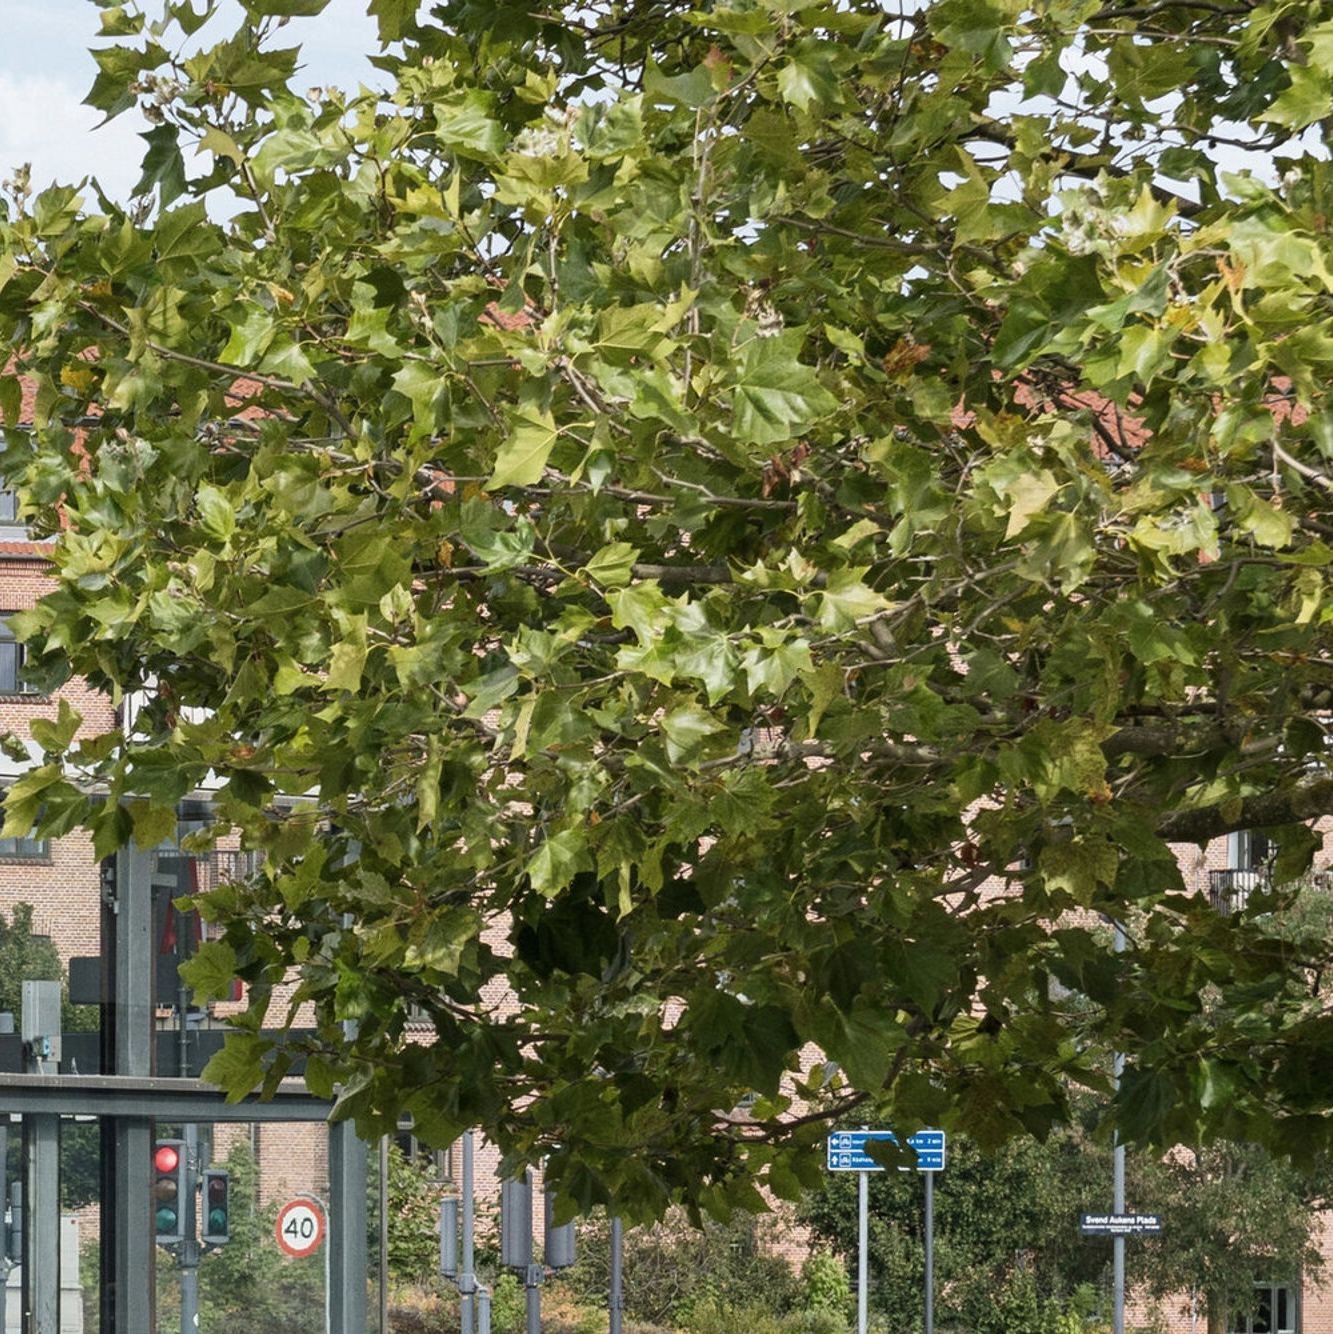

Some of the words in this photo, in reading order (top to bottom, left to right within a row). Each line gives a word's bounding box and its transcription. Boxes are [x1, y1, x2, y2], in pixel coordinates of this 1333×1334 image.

[1086, 1216, 1108, 1224] Svend
[1137, 1216, 1156, 1224] Plads
[284, 1217, 314, 1239] 40
